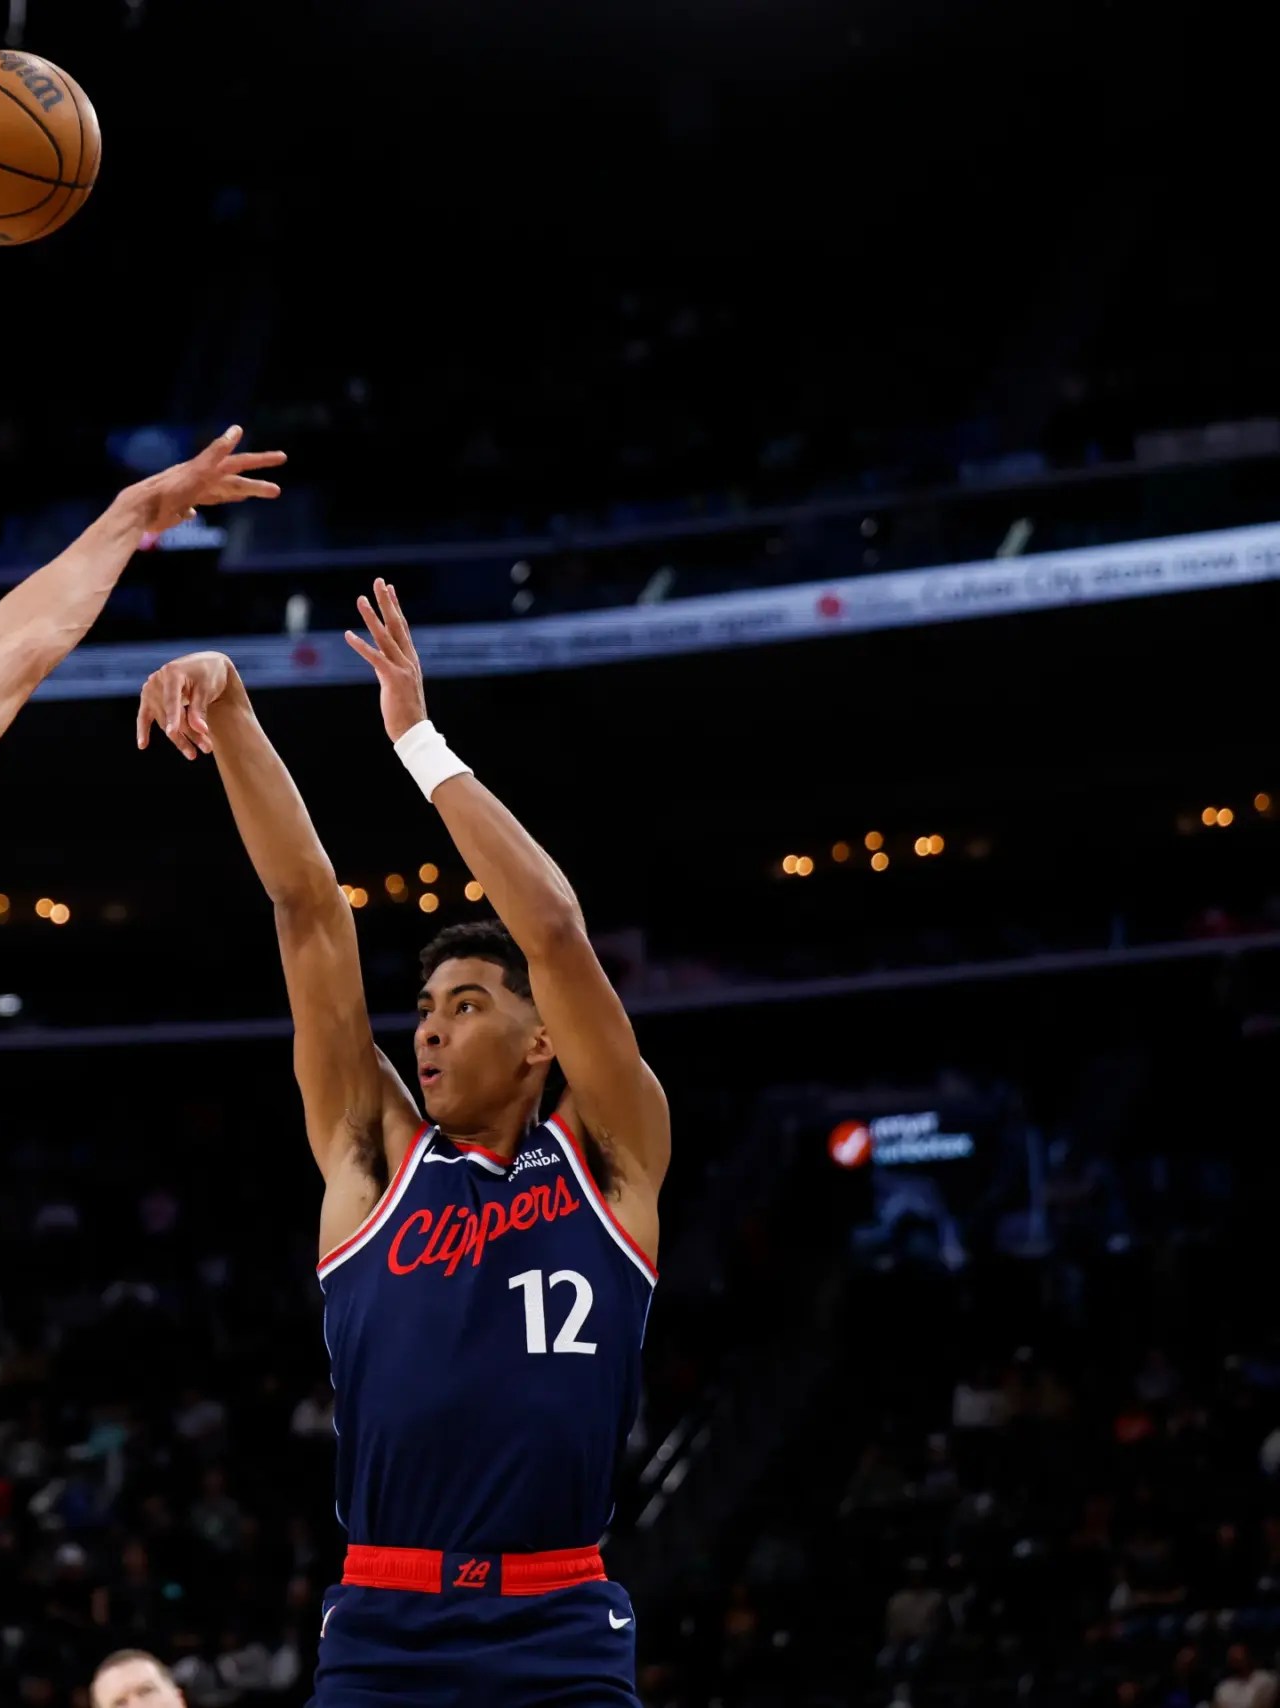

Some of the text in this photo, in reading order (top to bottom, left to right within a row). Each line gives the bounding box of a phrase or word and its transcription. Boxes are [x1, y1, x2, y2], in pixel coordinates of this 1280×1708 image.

[508, 1152, 561, 1183] RWANDA
[513, 1148, 544, 1166] VISIT
[387, 1174, 580, 1276] Clippers
[508, 1269, 598, 1355] 12
